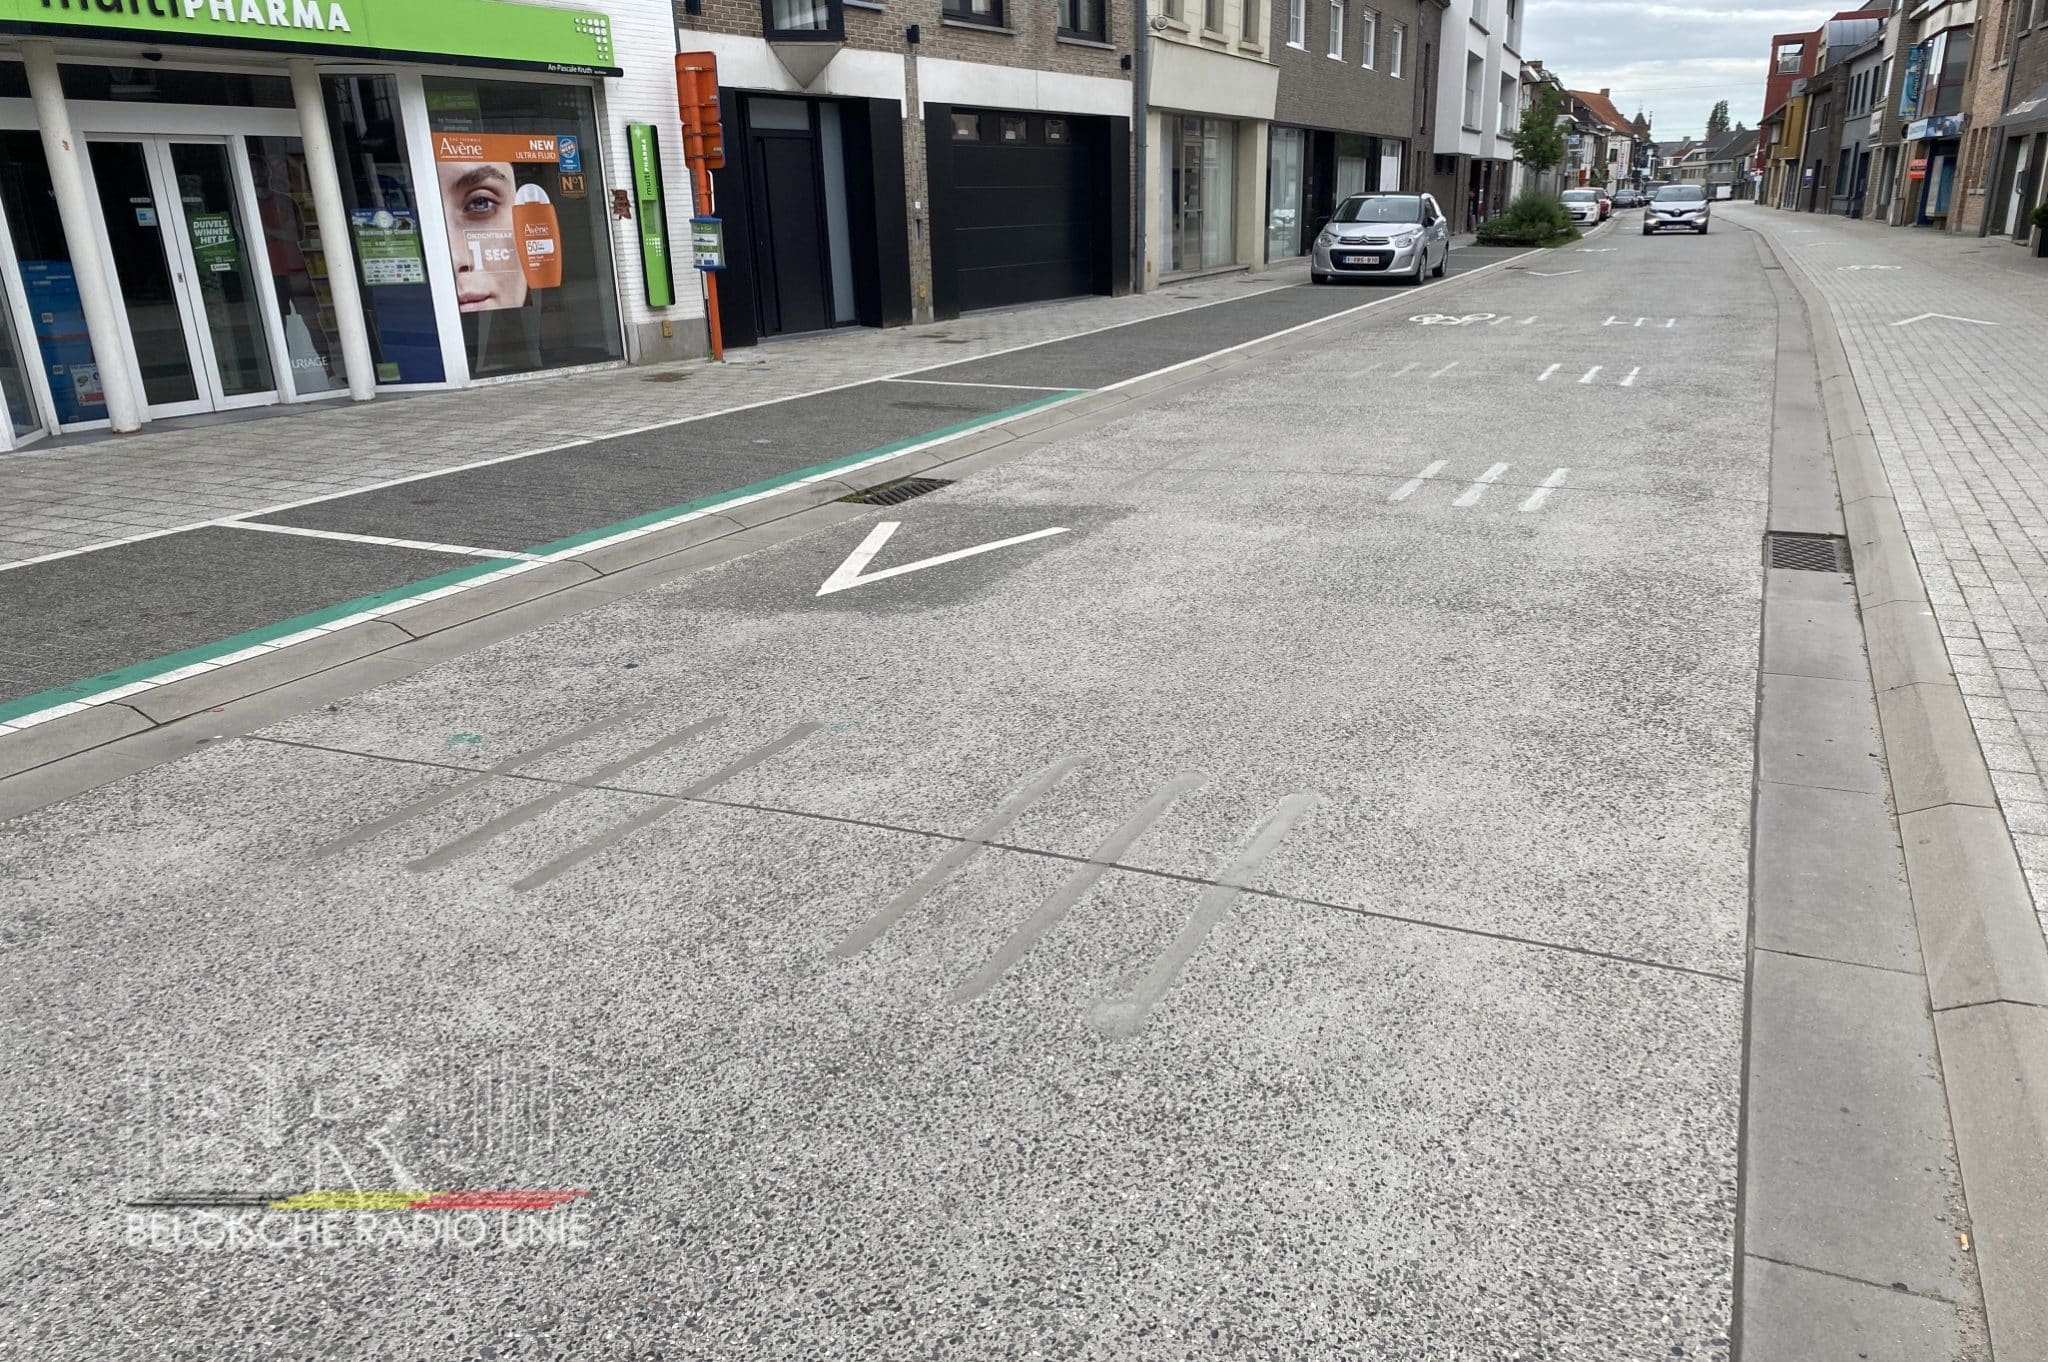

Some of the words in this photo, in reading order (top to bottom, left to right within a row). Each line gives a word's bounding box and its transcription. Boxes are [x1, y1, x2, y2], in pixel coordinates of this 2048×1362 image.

[41, 0, 352, 32] PHARMA
[440, 137, 482, 156] Avène
[529, 139, 554, 151] NEW
[515, 151, 536, 160] ULTRA
[538, 152, 556, 160] FLUID
[641, 139, 653, 196] multiPHARMA
[193, 220, 228, 229] DUIVELS
[524, 223, 549, 234] Avène
[194, 227, 230, 237] WINNEN
[200, 236, 217, 244] HET
[467, 240, 484, 270] 1
[484, 248, 511, 261] SEC
[291, 356, 329, 369] URIAGE
